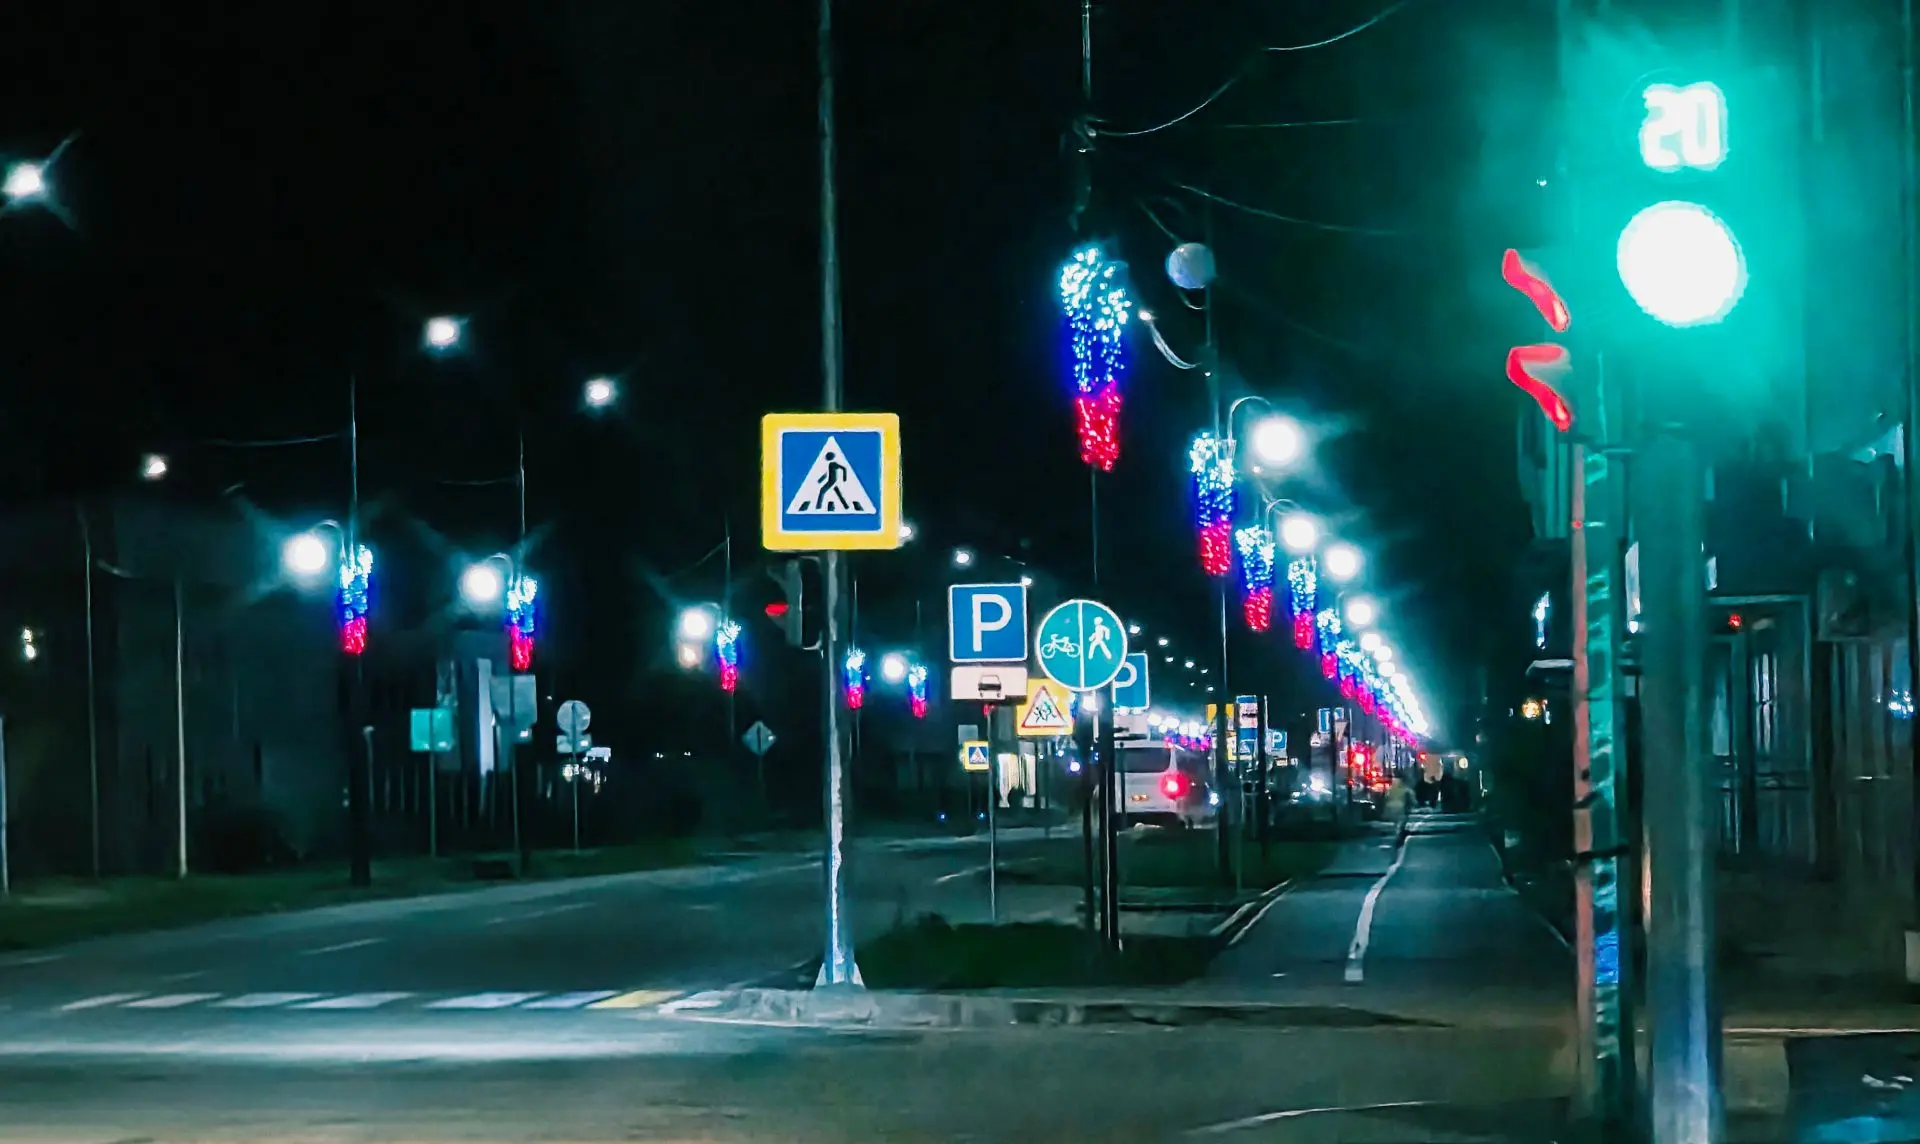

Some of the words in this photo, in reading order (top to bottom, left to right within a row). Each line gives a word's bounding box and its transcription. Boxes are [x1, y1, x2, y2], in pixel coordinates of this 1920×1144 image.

[1640, 82, 1728, 172] 20
[972, 593, 1012, 652] P
[1112, 661, 1138, 703] P
[1272, 731, 1283, 747] P
